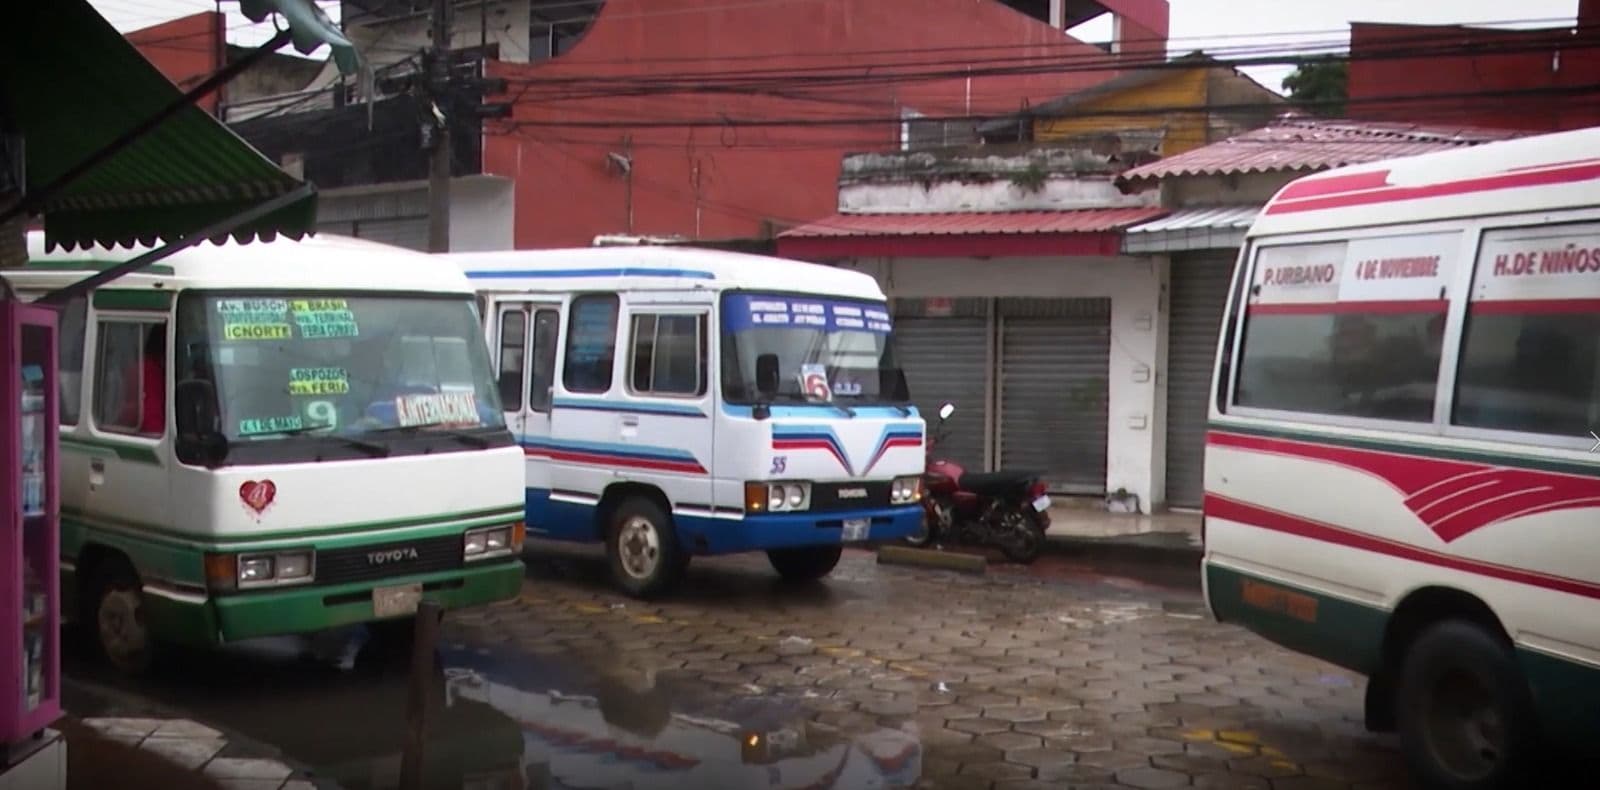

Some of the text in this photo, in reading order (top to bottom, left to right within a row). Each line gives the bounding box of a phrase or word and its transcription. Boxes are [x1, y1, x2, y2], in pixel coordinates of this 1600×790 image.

[1380, 255, 1440, 279] NOVIEMBRE
[1493, 243, 1600, 277] H.DE NIÑOS
[1263, 263, 1335, 286] P.URBANO
[242, 300, 286, 312] BUSCH
[311, 381, 347, 394] FERIA
[806, 373, 828, 401] 6
[307, 401, 337, 431] 9
[769, 456, 787, 475] 55
[367, 547, 418, 565] TOYOTA
